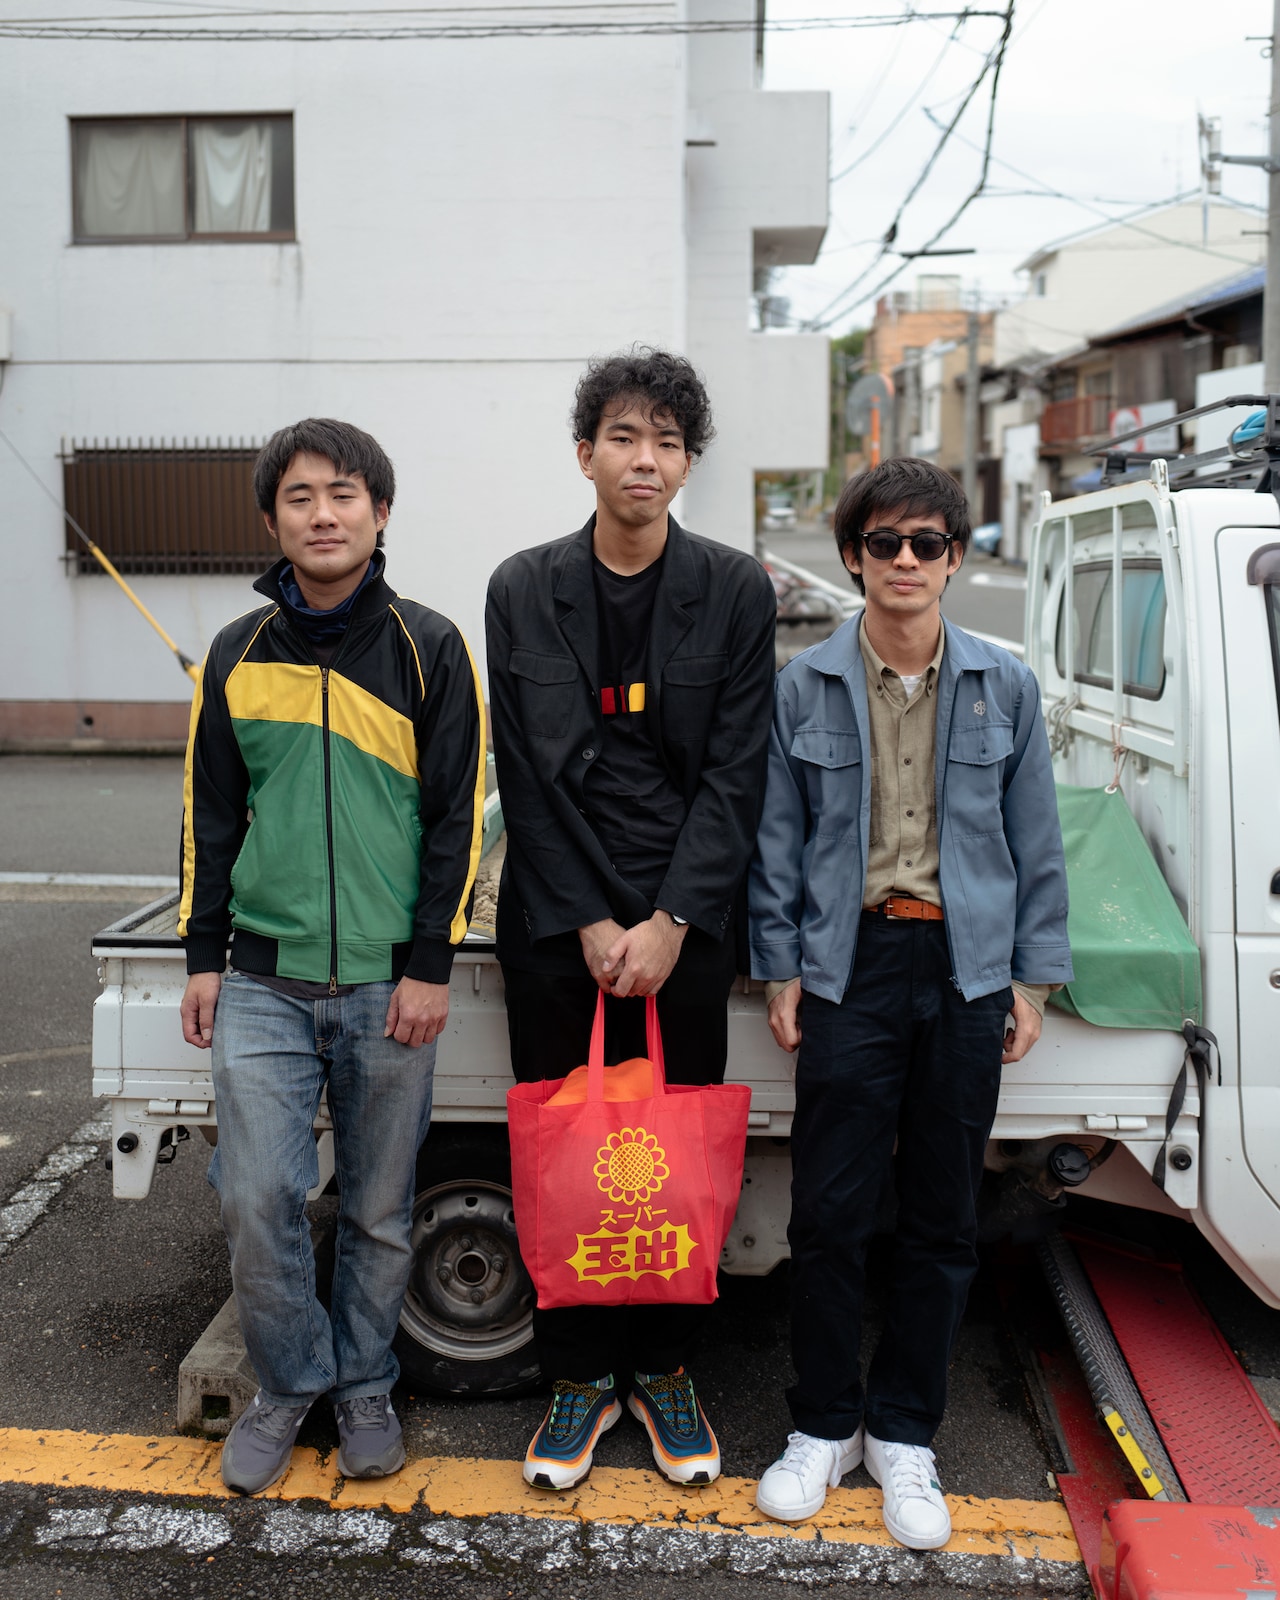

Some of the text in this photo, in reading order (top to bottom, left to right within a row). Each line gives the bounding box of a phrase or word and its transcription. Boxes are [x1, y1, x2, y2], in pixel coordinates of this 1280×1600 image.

[600, 1205, 667, 1225] スーパー
[582, 1230, 678, 1276] 玉出
